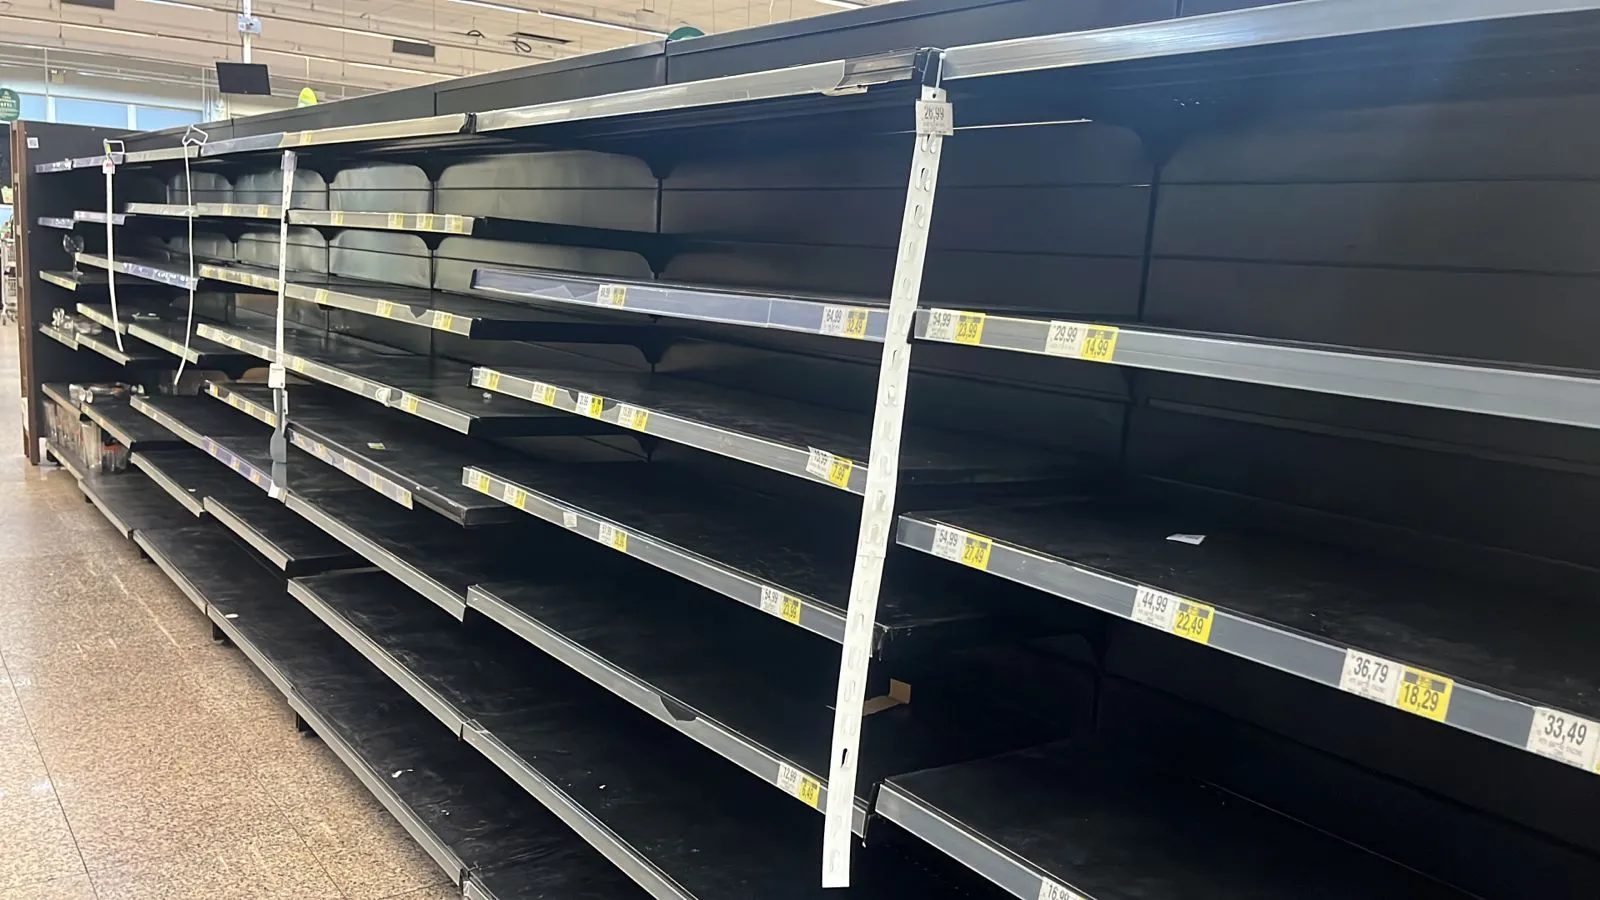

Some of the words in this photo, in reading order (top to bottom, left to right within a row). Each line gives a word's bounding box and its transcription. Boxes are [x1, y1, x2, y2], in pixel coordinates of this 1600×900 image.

[932, 312, 952, 328] 54,99
[957, 322, 978, 339] 23,99
[1054, 325, 1077, 343] 29,99
[1084, 338, 1109, 357] 14,99
[938, 528, 959, 547] 54,99
[963, 543, 985, 563] 27,49
[1141, 591, 1168, 613] 44,99
[1176, 612, 1204, 635] 22,49
[1353, 656, 1389, 684] 36,79
[1403, 683, 1439, 712] 18,29
[1544, 714, 1588, 746] 33,49
